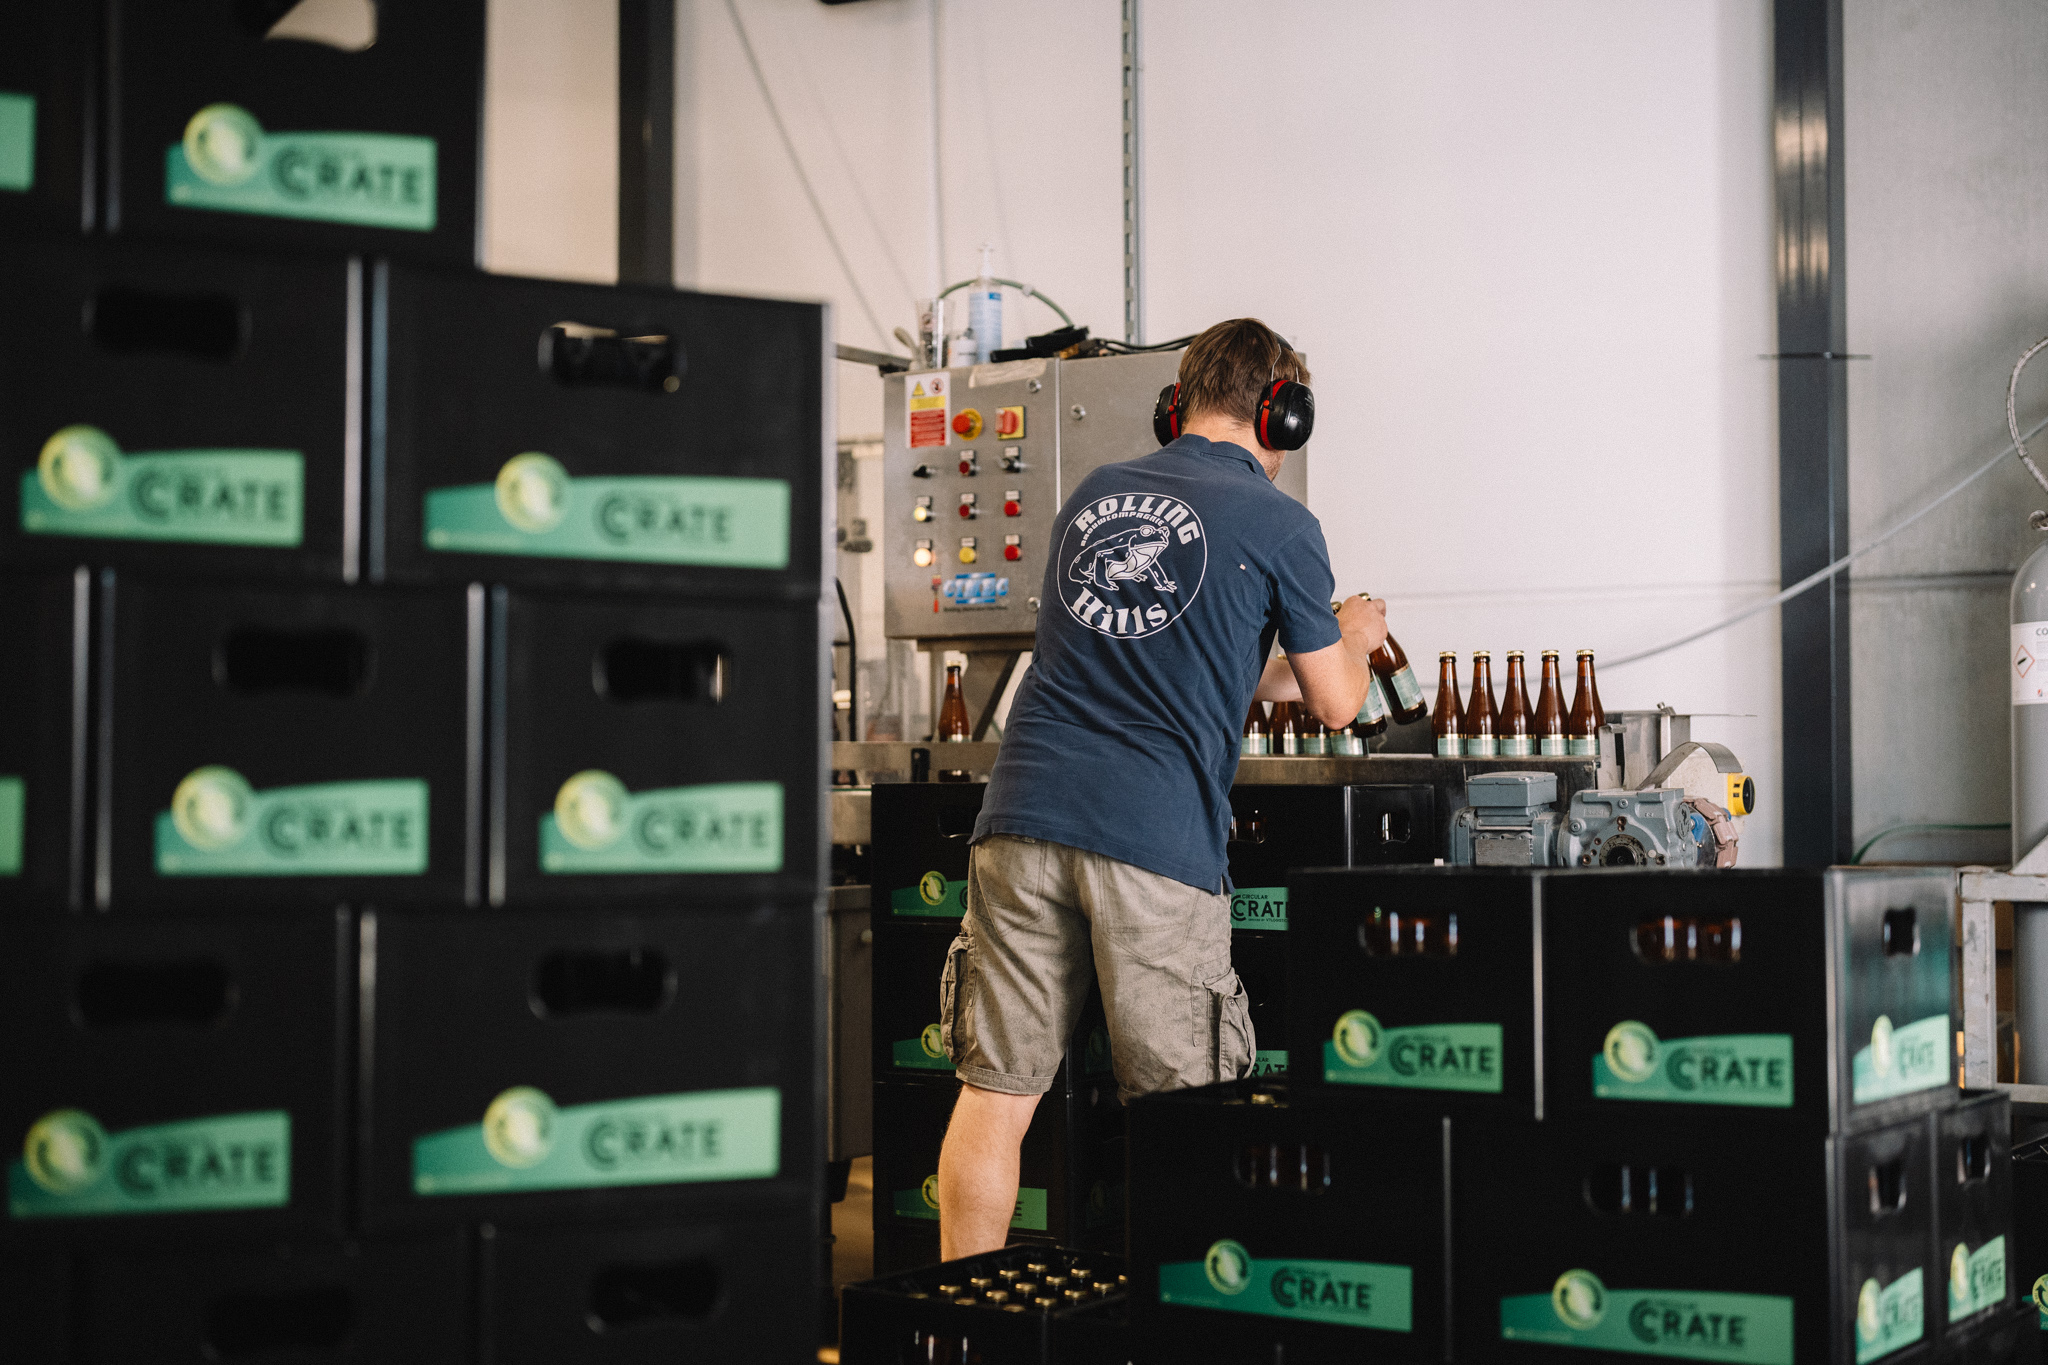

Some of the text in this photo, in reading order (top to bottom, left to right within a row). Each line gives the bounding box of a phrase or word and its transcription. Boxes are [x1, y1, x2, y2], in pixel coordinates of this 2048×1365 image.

[270, 144, 423, 206] CRATE
[130, 465, 287, 525] CRATE
[592, 490, 734, 546] CRATE
[1075, 495, 1200, 545] ROLLING
[1080, 511, 1165, 547] BROUWCOMPAGNIE
[1070, 586, 1168, 635] Hills
[258, 805, 413, 859] CRATE
[634, 804, 769, 857] CRATE
[1231, 895, 1288, 921] CRAT
[1252, 1062, 1288, 1077] RAT
[1388, 1035, 1494, 1077] CRATE
[1665, 1048, 1785, 1091] CRATE
[580, 1116, 720, 1171] CRATE
[113, 1141, 276, 1200] CRATE
[1270, 1267, 1371, 1310] CRATE
[1628, 1299, 1747, 1347] CRATE
